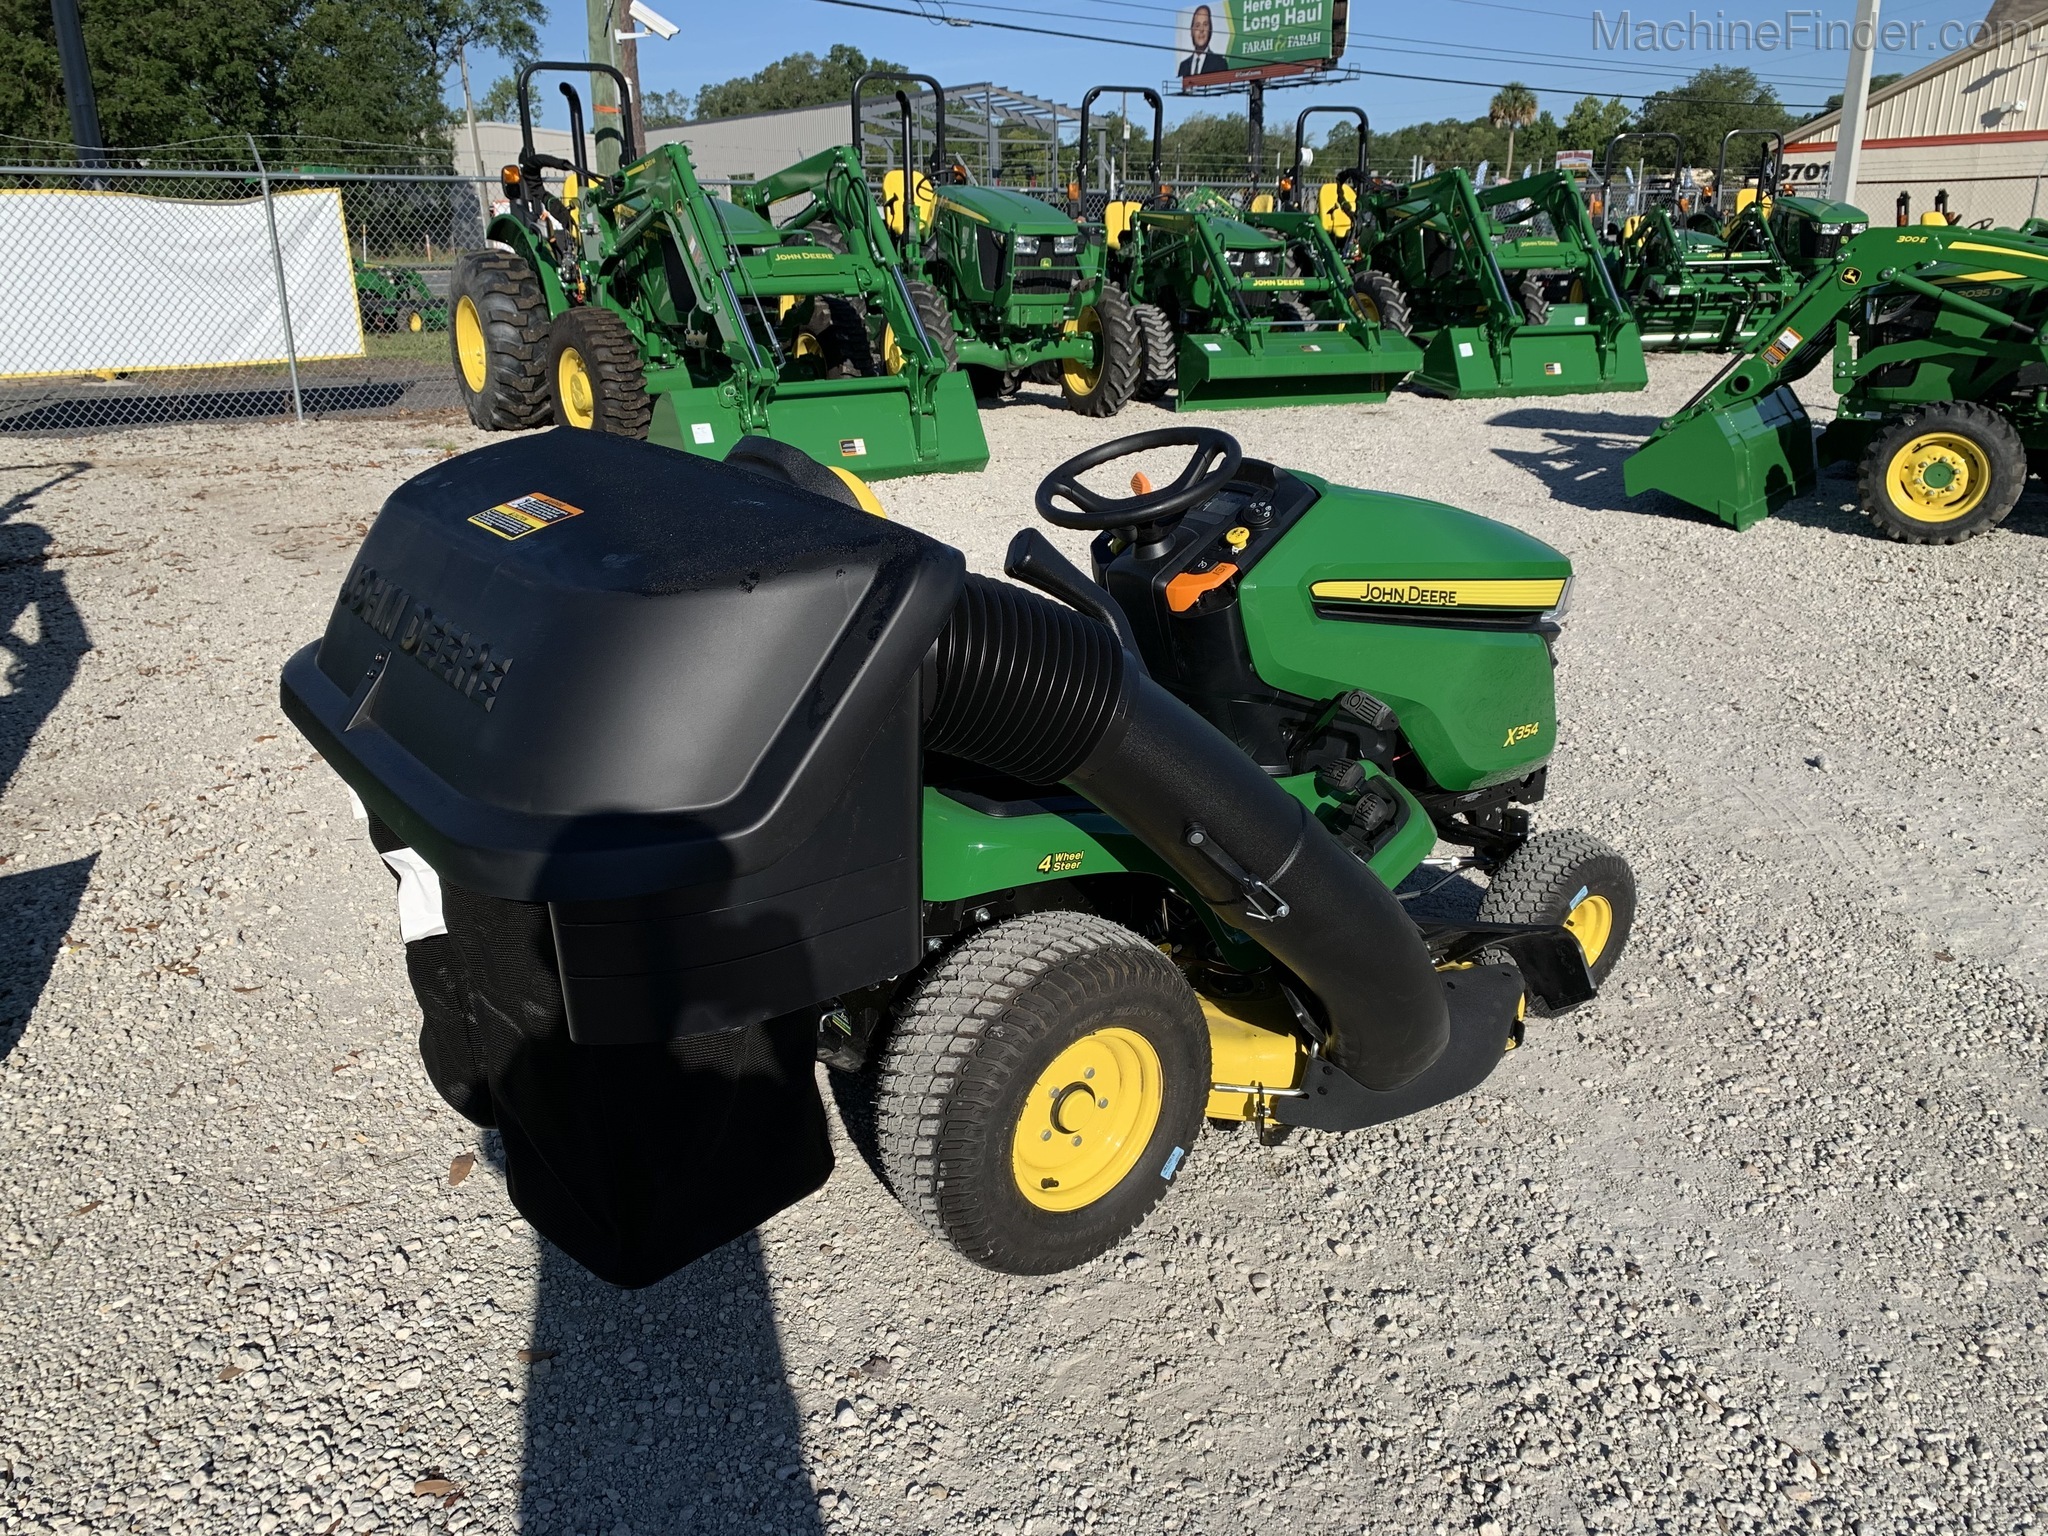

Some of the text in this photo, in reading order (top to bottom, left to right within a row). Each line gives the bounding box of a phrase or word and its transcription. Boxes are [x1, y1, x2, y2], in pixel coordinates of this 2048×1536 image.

[1243, 0, 1272, 14] Here
[1243, 2, 1322, 32] Long Haul
[1241, 38, 1274, 54] FARAH
[1287, 31, 1322, 48] FARAH
[775, 251, 835, 262] JOHN DEERE
[1253, 278, 1305, 287] JOHN DEERE
[1360, 583, 1458, 605] JOHN DEERE
[399, 602, 514, 713] DEERE
[1502, 721, 1540, 748] X354
[1038, 850, 1085, 872] 4 Wheel
[1053, 861, 1082, 872] Steer
